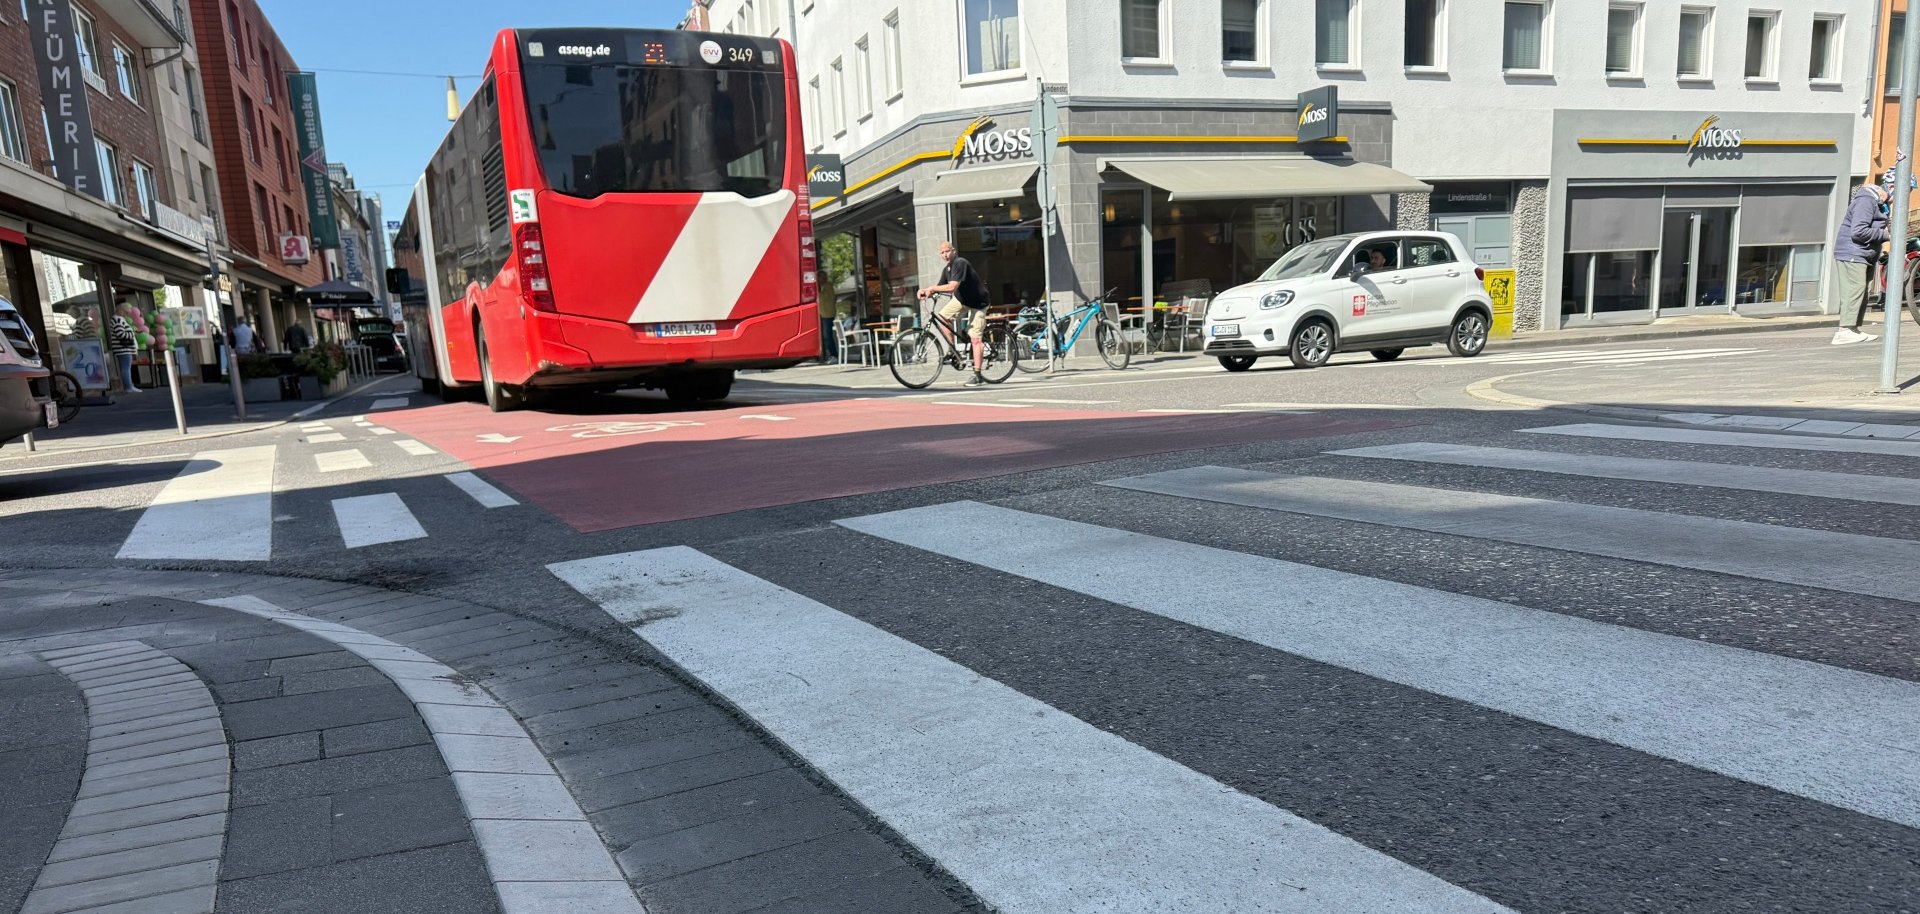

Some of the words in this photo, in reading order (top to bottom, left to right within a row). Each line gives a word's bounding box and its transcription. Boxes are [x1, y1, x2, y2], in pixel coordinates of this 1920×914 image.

[558, 44, 611, 58] aseag.de
[728, 47, 753, 62] 349
[38, 0, 88, 193] FÜMERIE
[1303, 107, 1327, 125] MOSS
[963, 127, 1032, 158] MOSS
[1696, 129, 1741, 148] MOSS
[811, 171, 842, 183] MOSS
[1448, 193, 1487, 201] Lindenstraße
[664, 324, 678, 335] AC
[693, 323, 712, 334] 349
